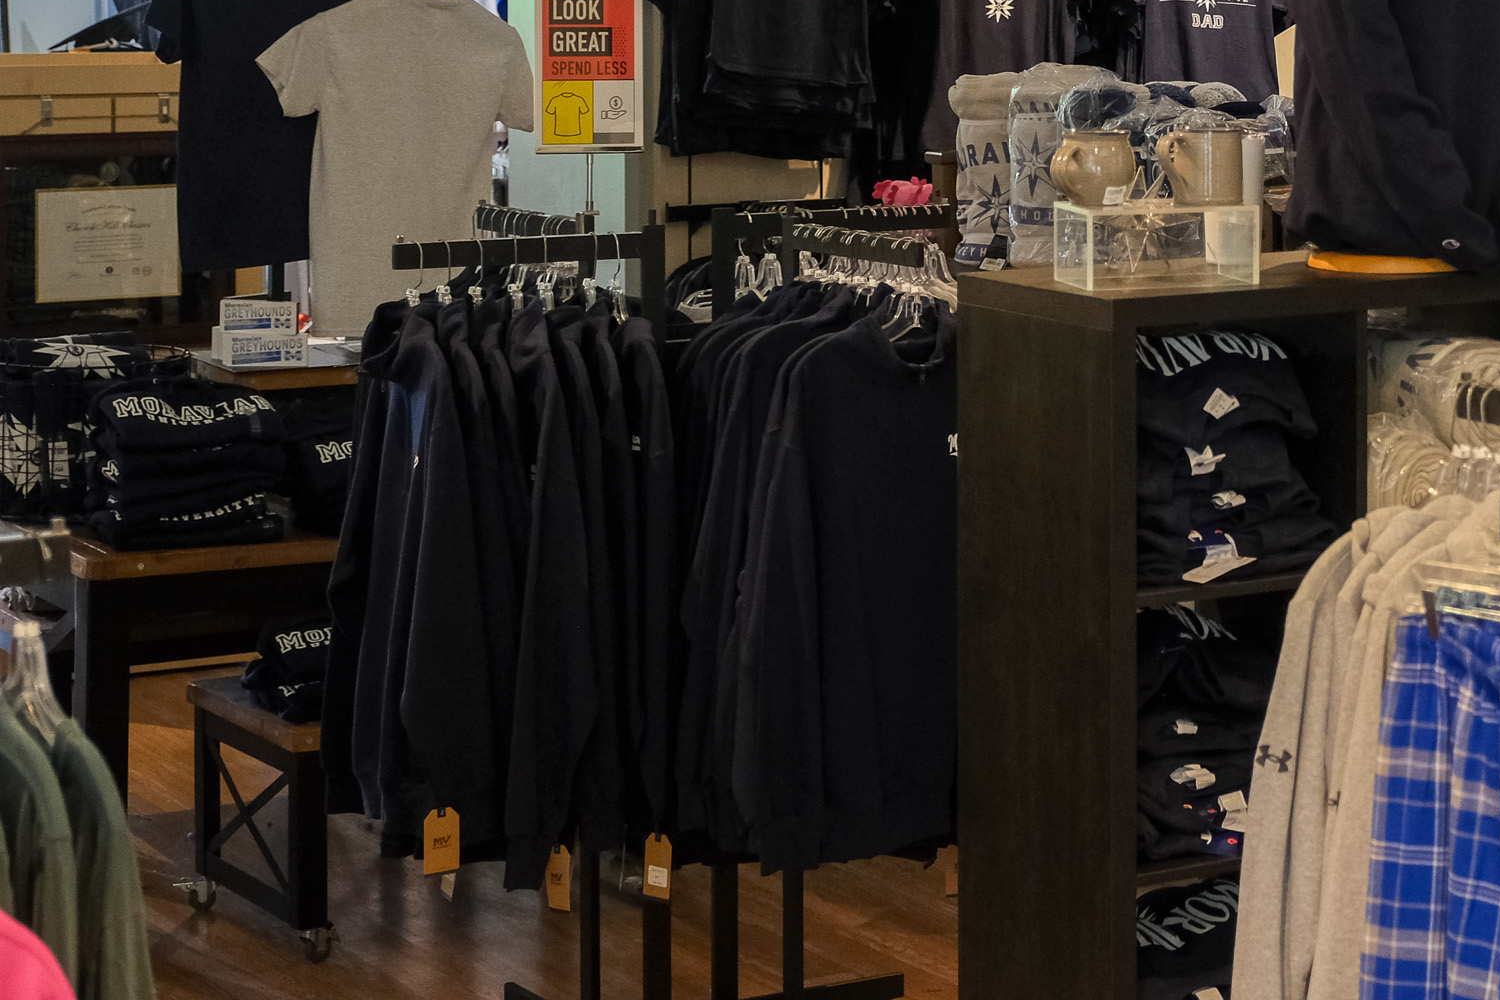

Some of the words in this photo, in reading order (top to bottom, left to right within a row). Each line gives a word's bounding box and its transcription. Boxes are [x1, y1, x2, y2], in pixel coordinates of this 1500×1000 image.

[552, 0, 601, 20] LOOK
[1191, 12, 1224, 30] DAD
[552, 31, 609, 53] GREAT
[551, 61, 592, 75] SPEND
[597, 61, 628, 75] LESS
[224, 306, 292, 319] GREYHOUNDS
[231, 338, 304, 354] GREYHOUNDS
